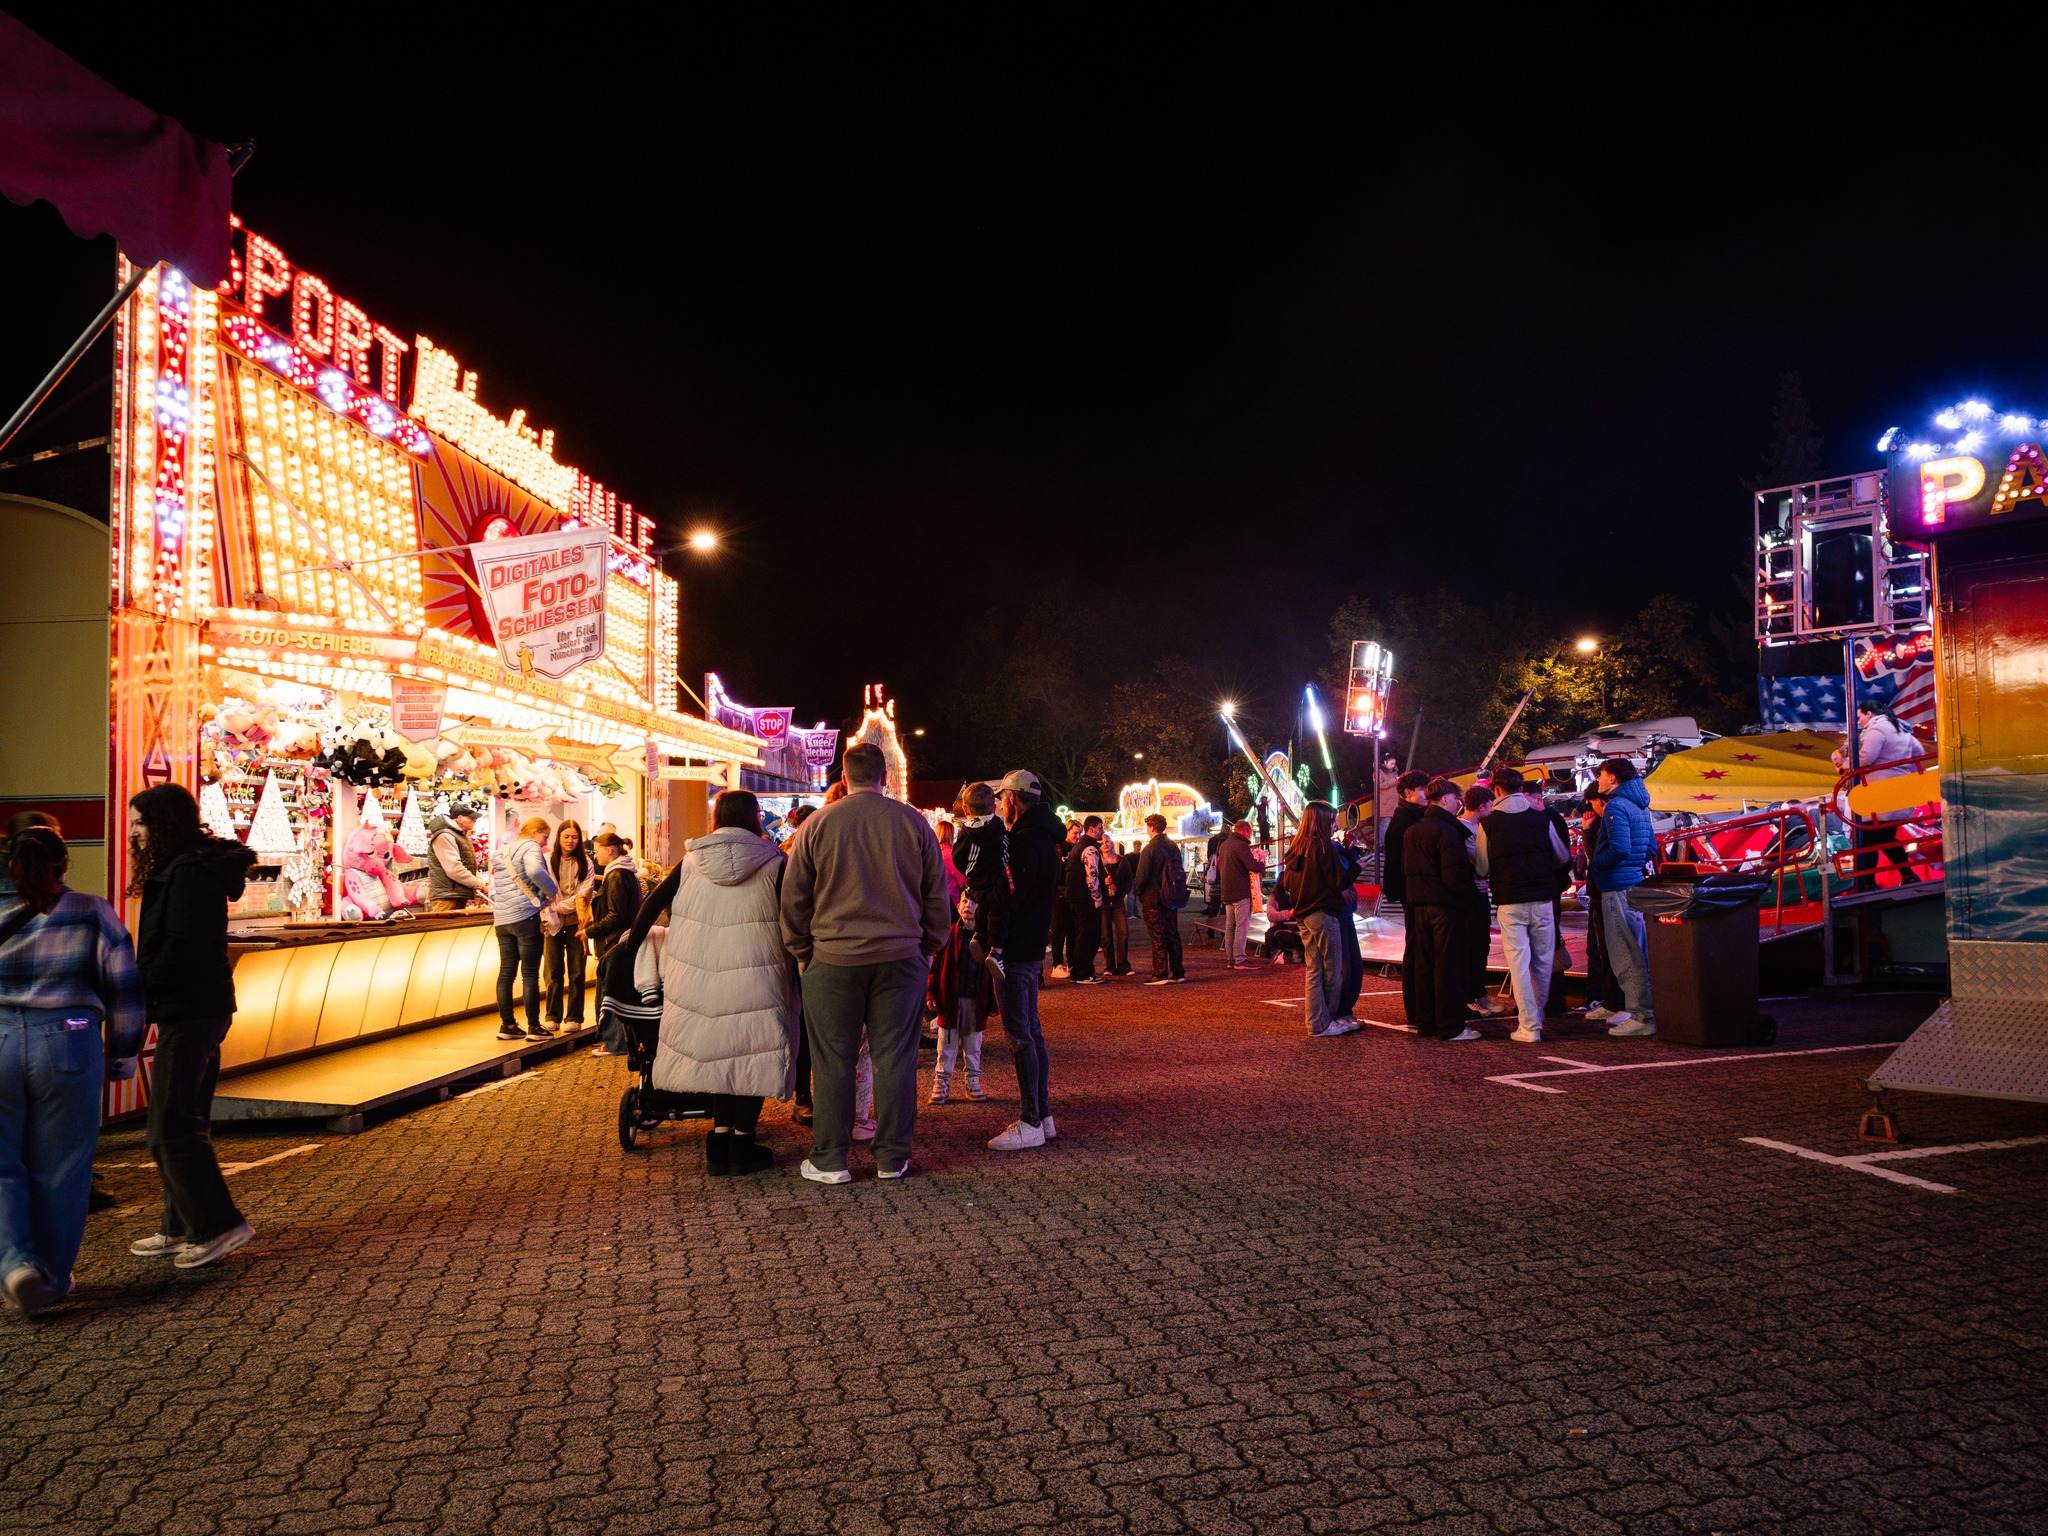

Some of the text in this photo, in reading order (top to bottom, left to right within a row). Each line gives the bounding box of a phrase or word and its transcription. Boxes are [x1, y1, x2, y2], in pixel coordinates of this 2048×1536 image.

[489, 545, 584, 590] DIGITALES
[521, 572, 597, 614] FOTO-
[498, 592, 604, 641] SCHIESSEN
[557, 622, 596, 643] Ihr Bild
[760, 718, 782, 730] STOP
